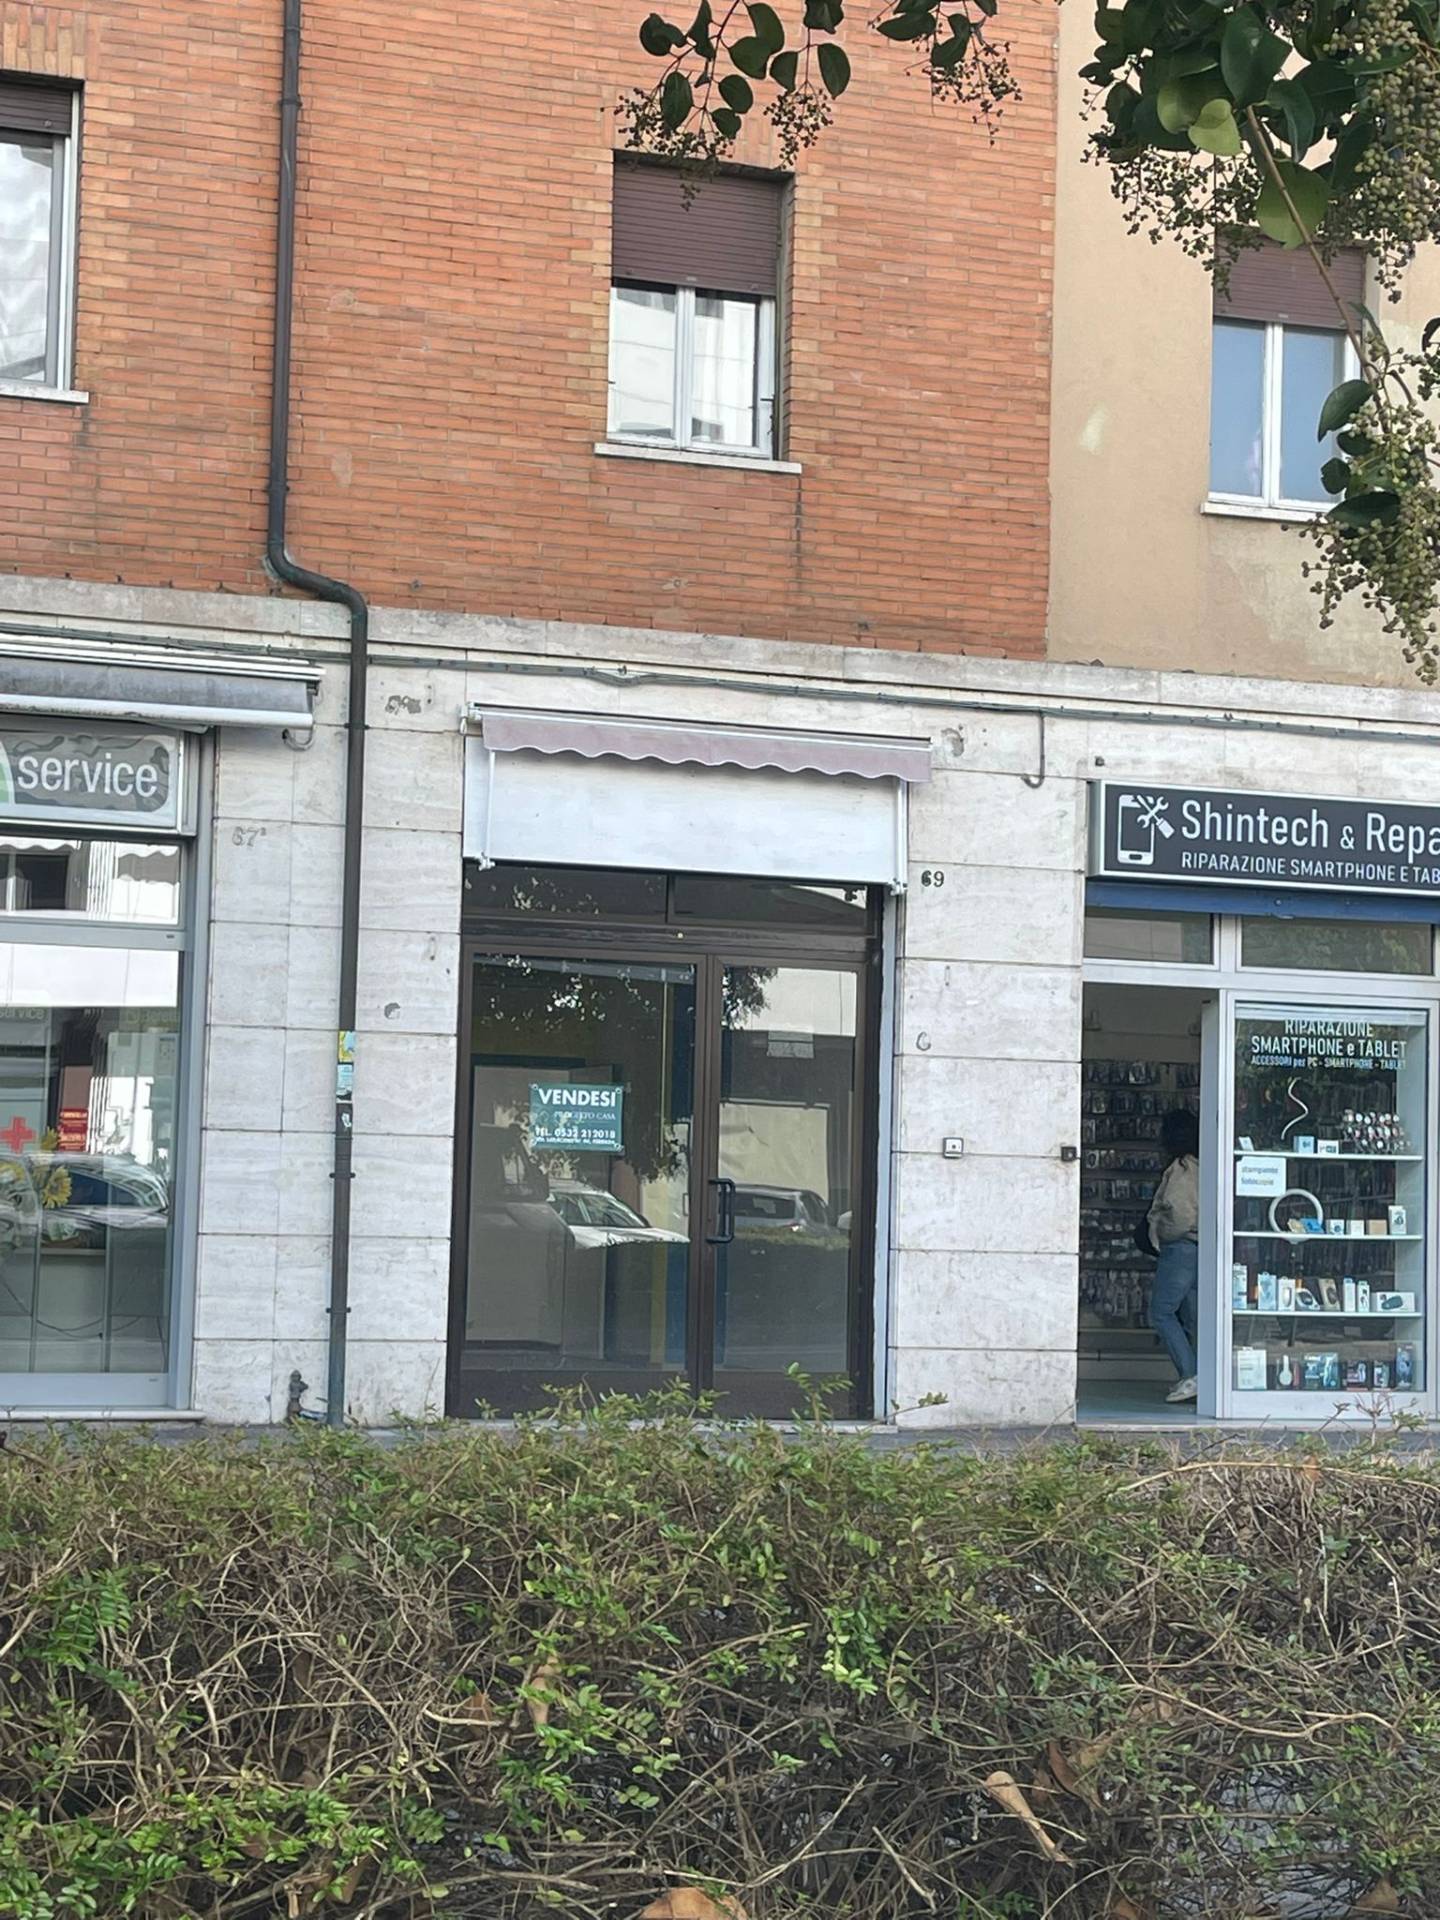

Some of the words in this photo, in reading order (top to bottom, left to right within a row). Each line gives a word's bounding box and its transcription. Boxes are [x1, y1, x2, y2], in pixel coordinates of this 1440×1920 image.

[17, 753, 158, 797] service
[1181, 799, 1329, 848] Shintech
[1339, 825, 1355, 850] &
[921, 870, 945, 887] 69
[1181, 851, 1286, 875] RIPARAZIONE
[1290, 858, 1396, 882] SMARTPHONE
[1400, 865, 1409, 883] E
[1412, 866, 1440, 885] TAB
[1285, 1019, 1374, 1037] RIPARAZIONE
[1251, 1035, 1344, 1057] SMARTPHONE
[1346, 1042, 1355, 1056] e
[1358, 1039, 1407, 1058] TABLET
[1251, 1055, 1292, 1067] ACCESSORI
[538, 1088, 616, 1107] VENDESI
